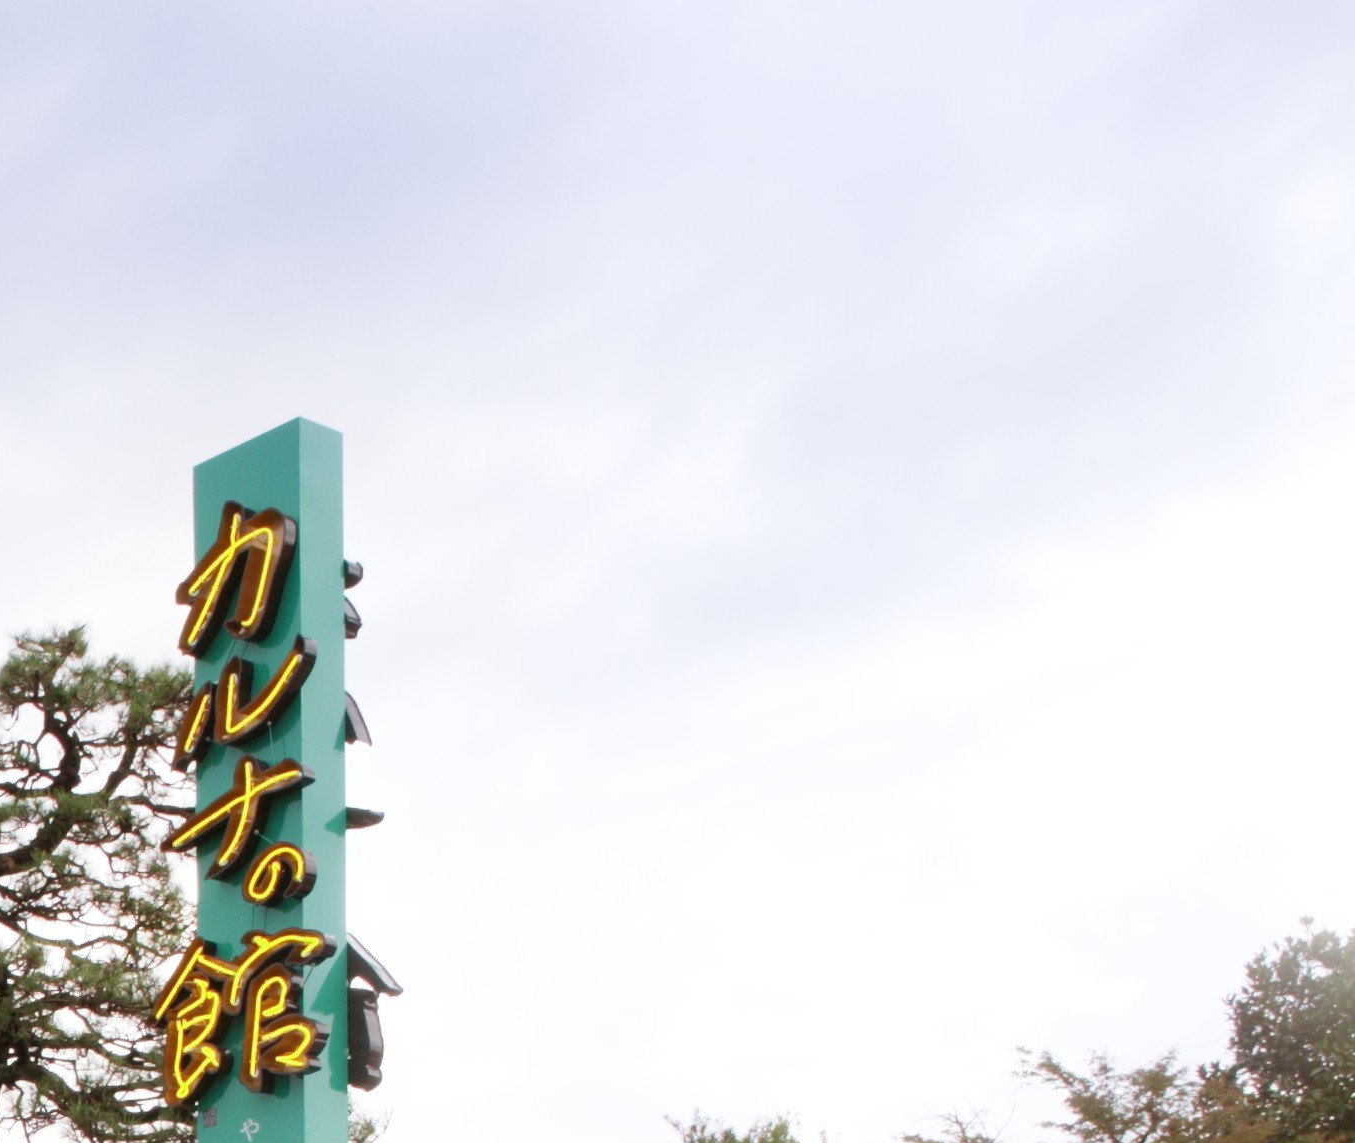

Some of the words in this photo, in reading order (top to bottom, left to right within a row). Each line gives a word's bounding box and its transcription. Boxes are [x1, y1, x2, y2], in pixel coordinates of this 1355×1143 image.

[155, 500, 336, 1107] カルナの館
